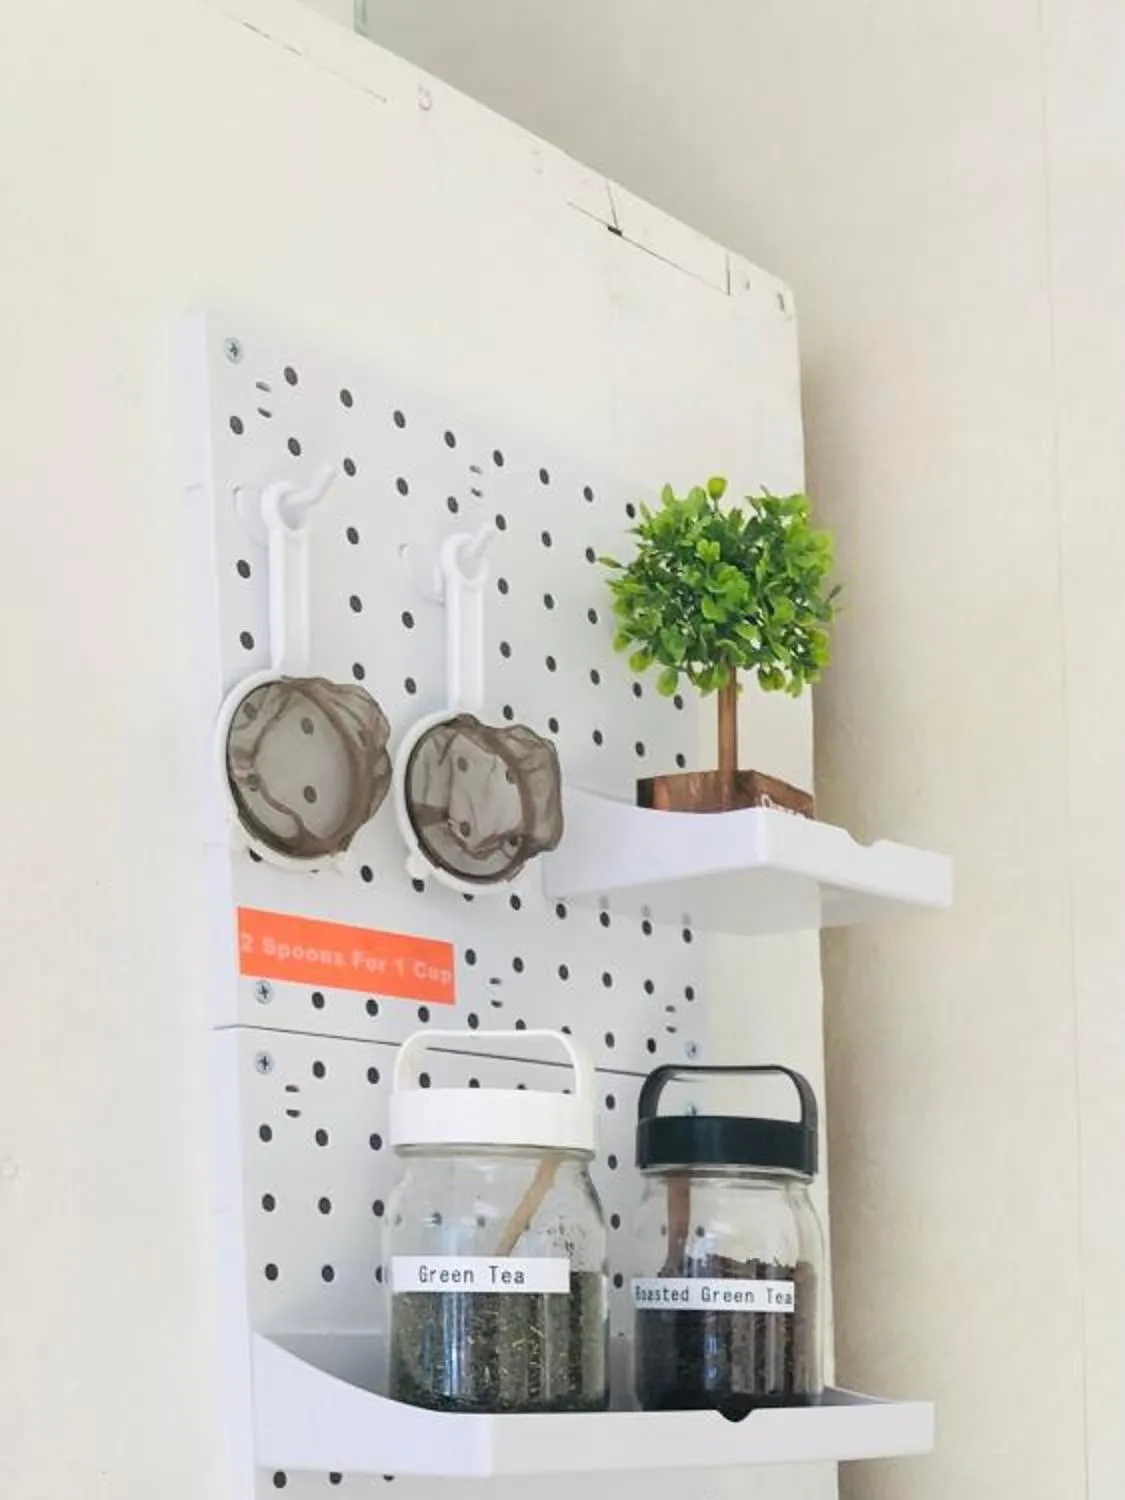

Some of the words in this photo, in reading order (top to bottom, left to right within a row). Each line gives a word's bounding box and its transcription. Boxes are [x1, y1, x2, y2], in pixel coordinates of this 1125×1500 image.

[240, 933, 254, 951] 2
[262, 936, 345, 966] Spoons
[352, 950, 386, 972] For
[396, 959, 405, 976] 1
[413, 962, 453, 985] Cup
[418, 1265, 475, 1284] Green
[489, 1265, 526, 1285] Tea
[701, 1286, 755, 1303] Green
[766, 1287, 793, 1305] Tea
